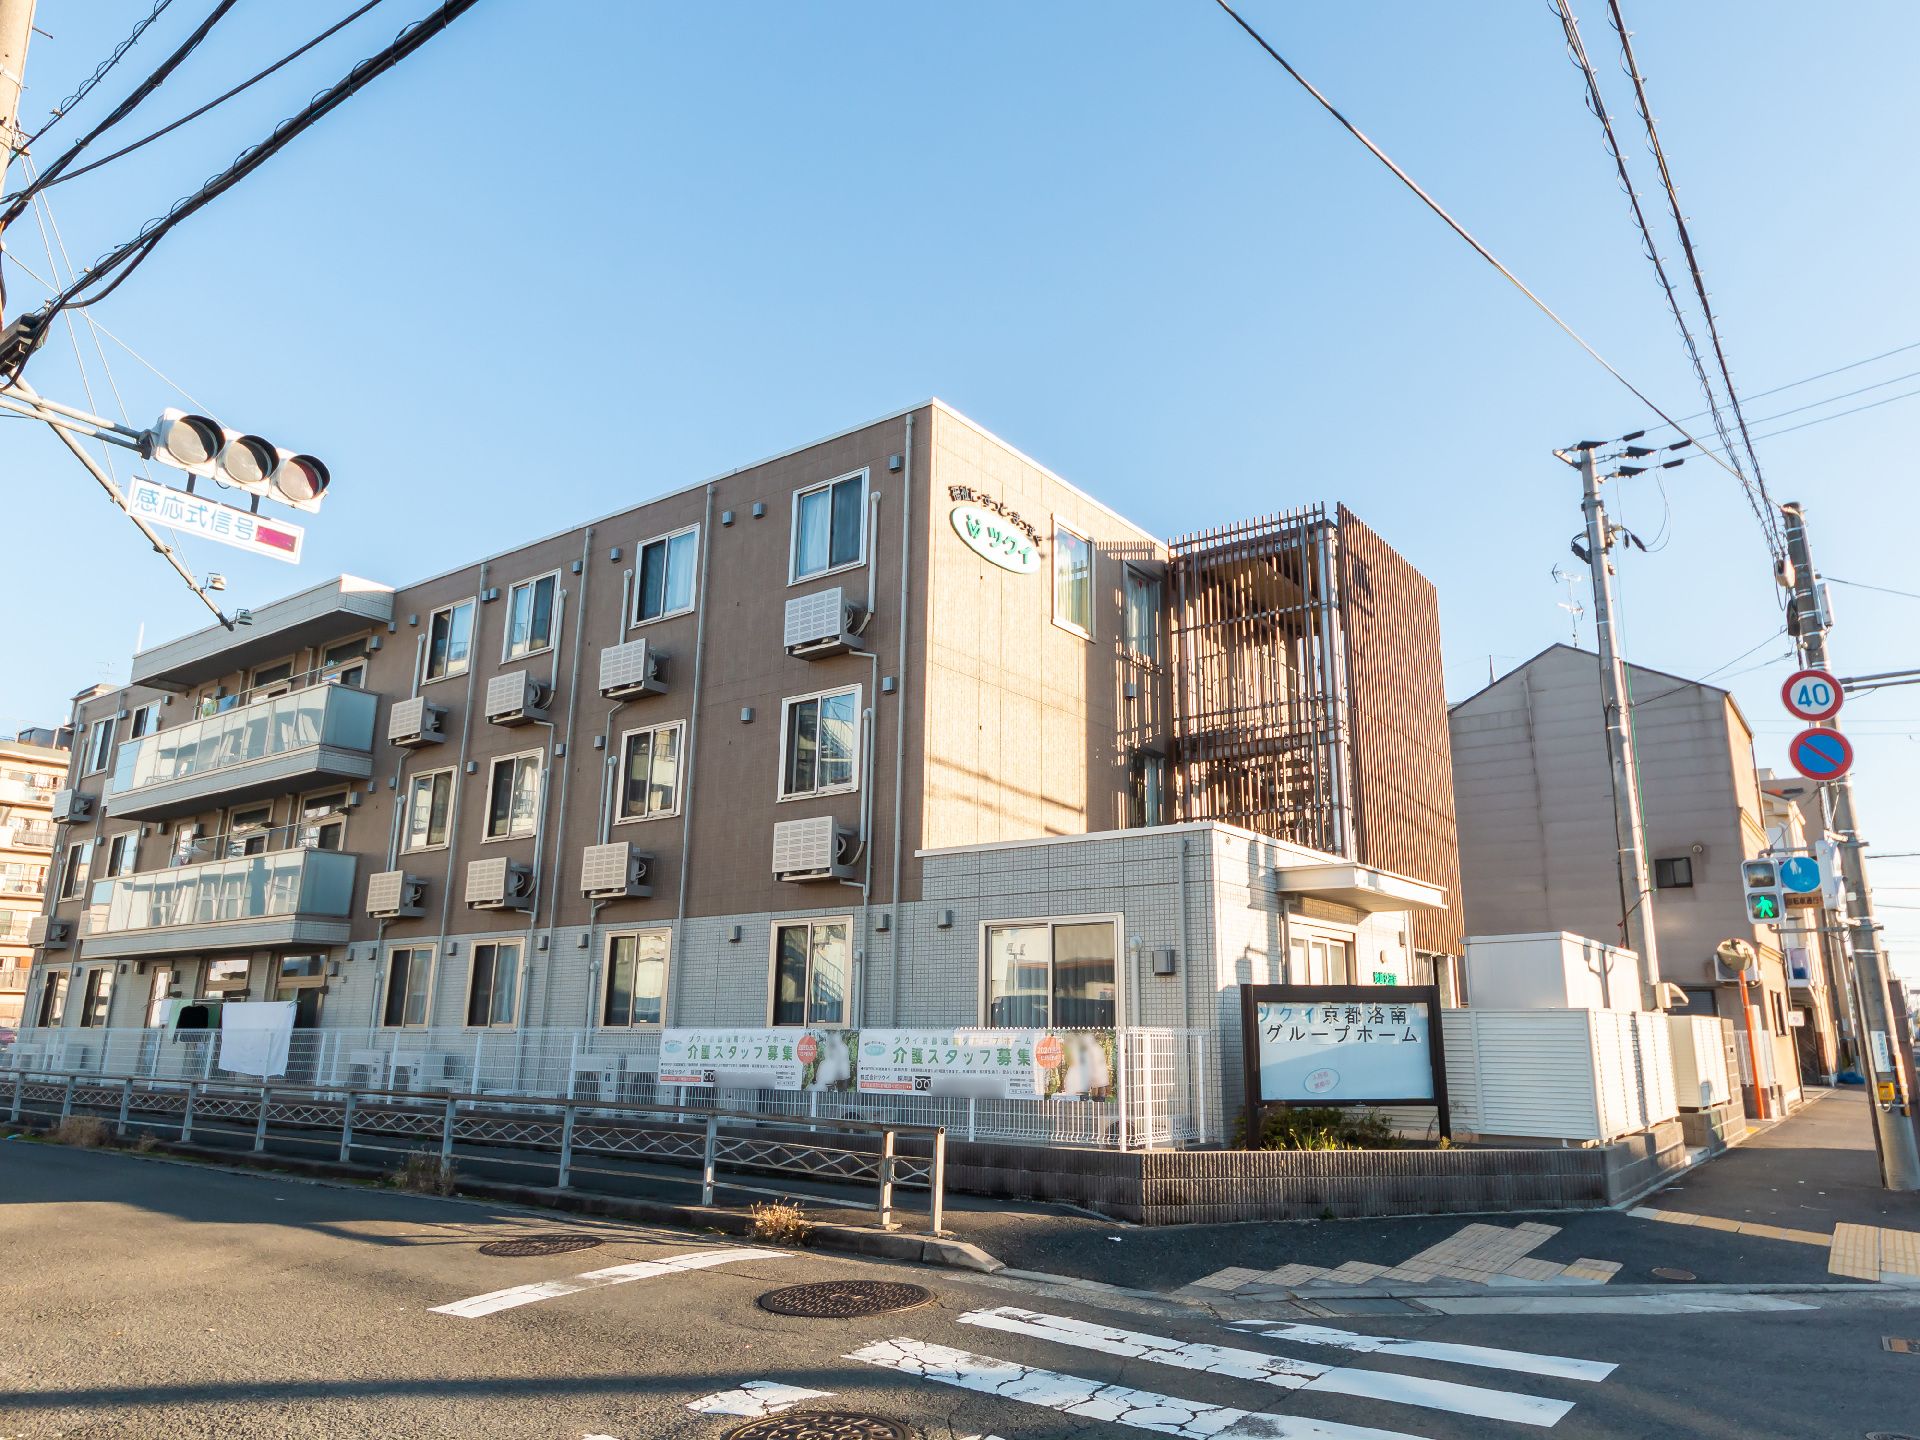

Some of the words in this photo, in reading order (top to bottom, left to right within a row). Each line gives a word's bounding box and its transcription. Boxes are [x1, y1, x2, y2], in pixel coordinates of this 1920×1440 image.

[135, 486, 255, 542] 感応式信号
[1797, 683, 1831, 707] 40
[1266, 1025, 1418, 1044] グループホーム
[687, 1043, 793, 1061] 介護スタッフ募集
[893, 1046, 1031, 1066] 介護スタッフ募集
